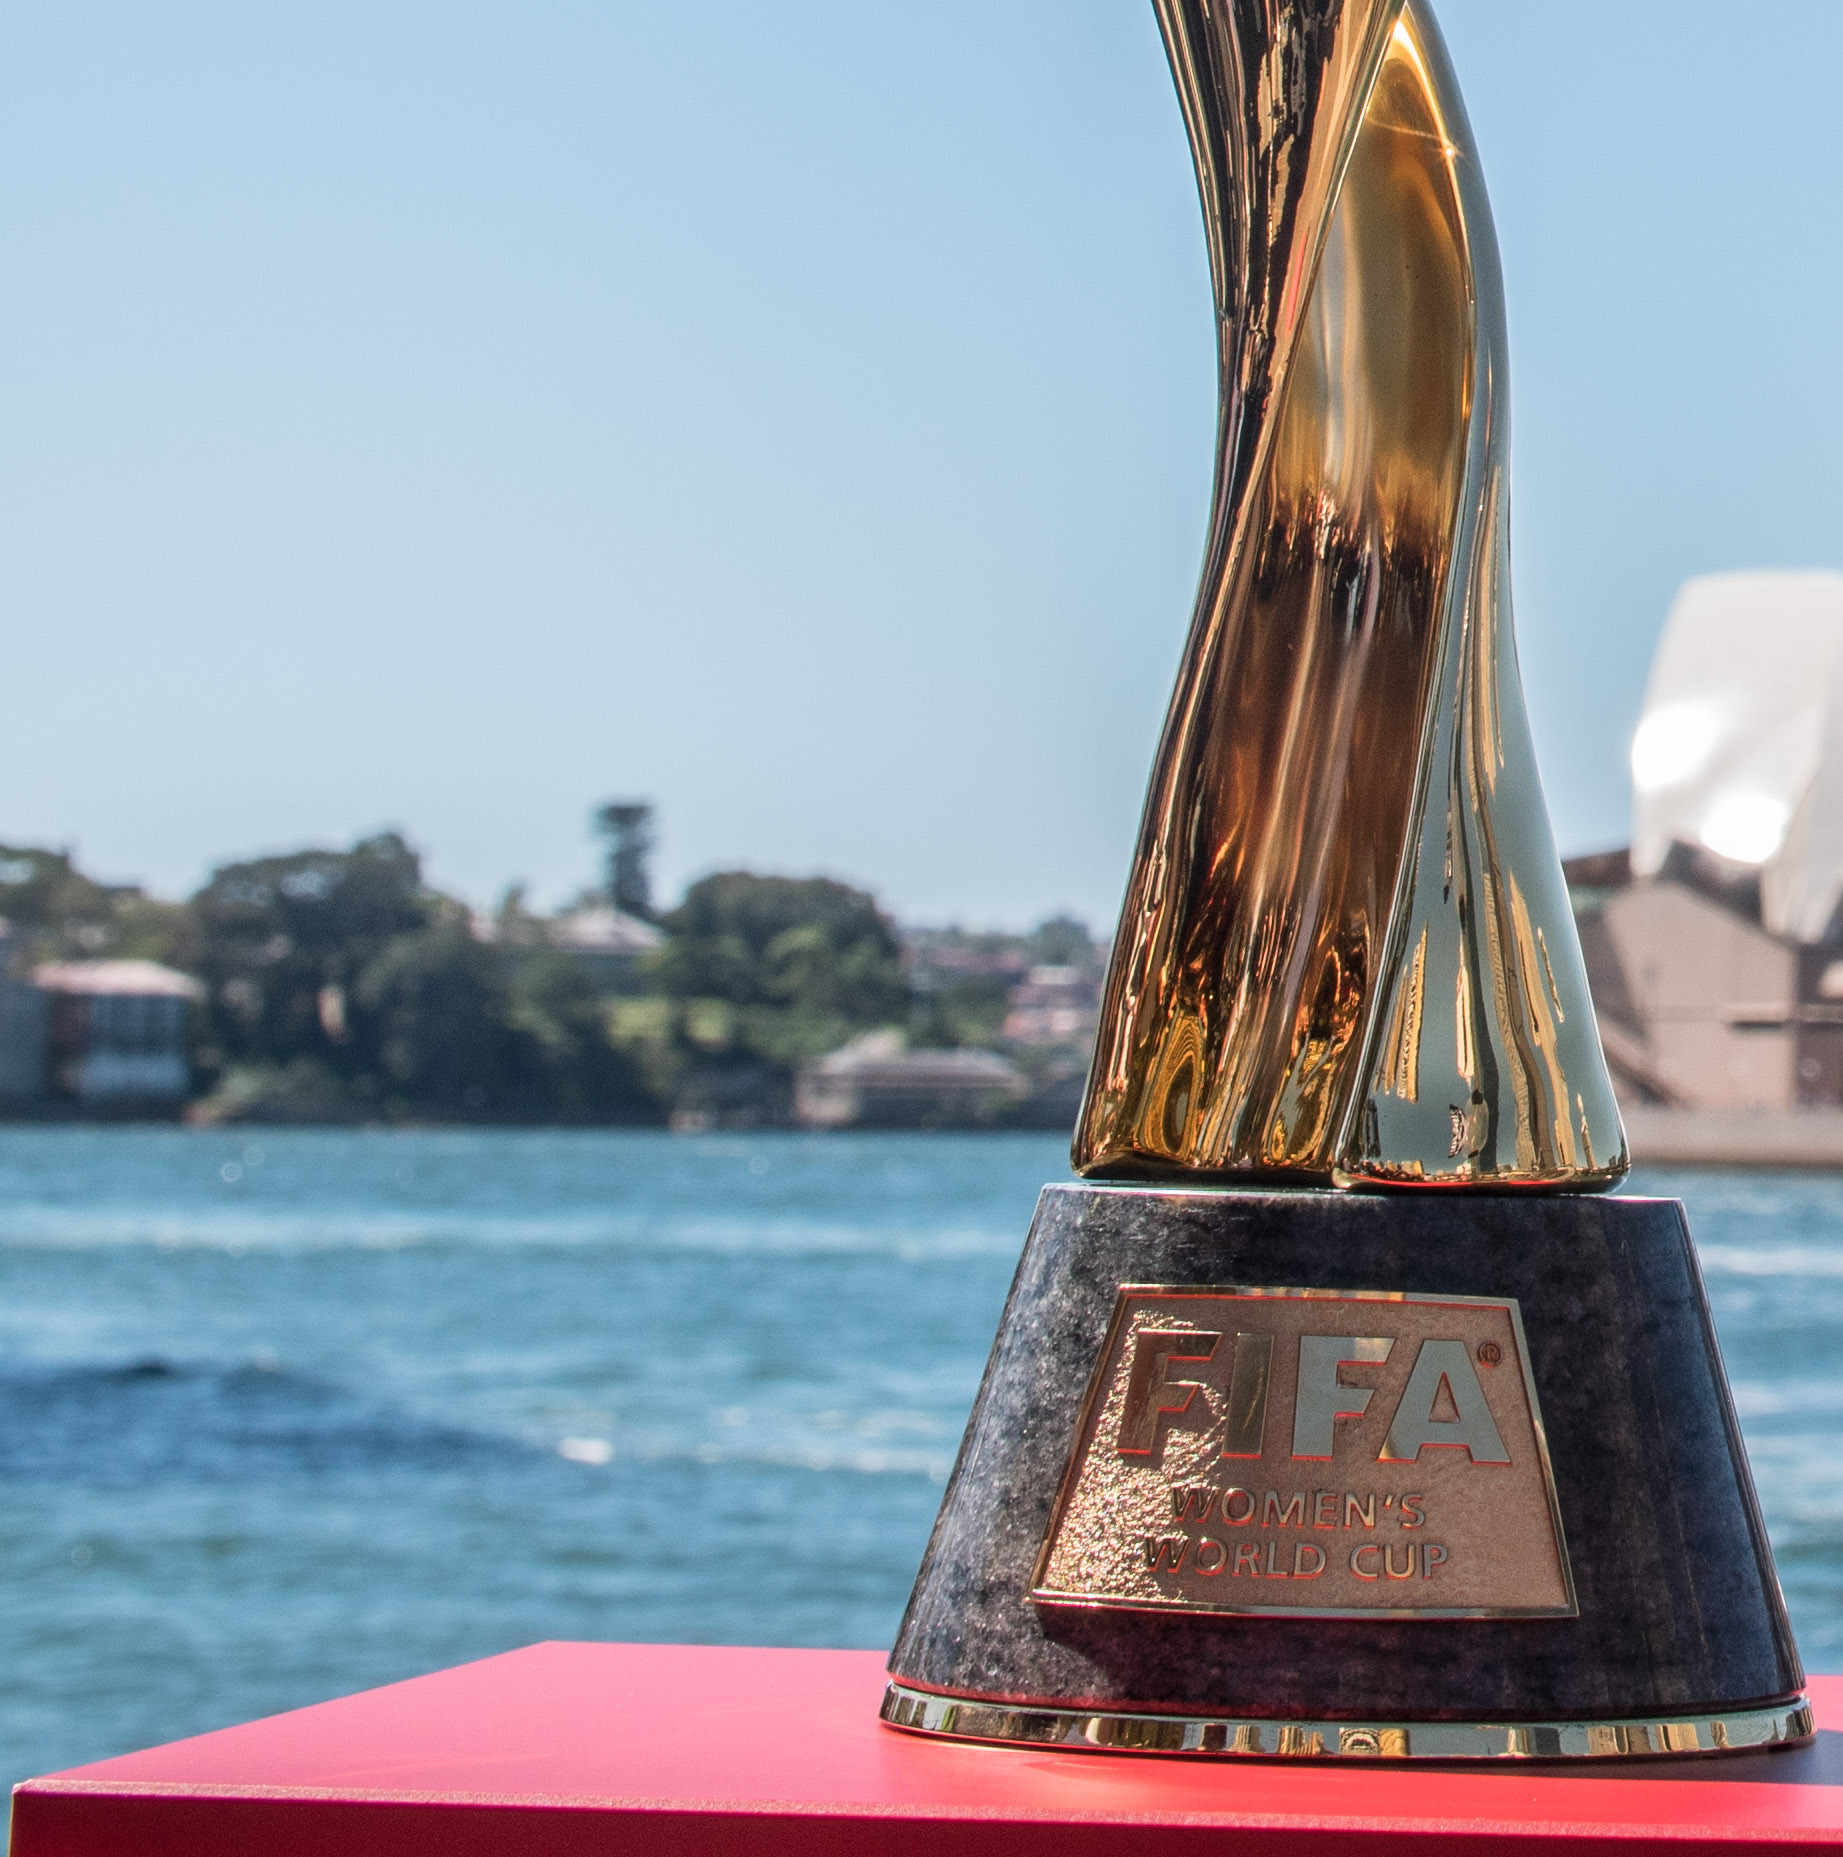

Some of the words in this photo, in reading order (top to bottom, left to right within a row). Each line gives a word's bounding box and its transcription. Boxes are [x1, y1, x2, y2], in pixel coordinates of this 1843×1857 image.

[1171, 1485, 1426, 1529] WOMEN'S
[1144, 1536, 1327, 1580] WORLD
[1350, 1544, 1450, 1581] CUP
